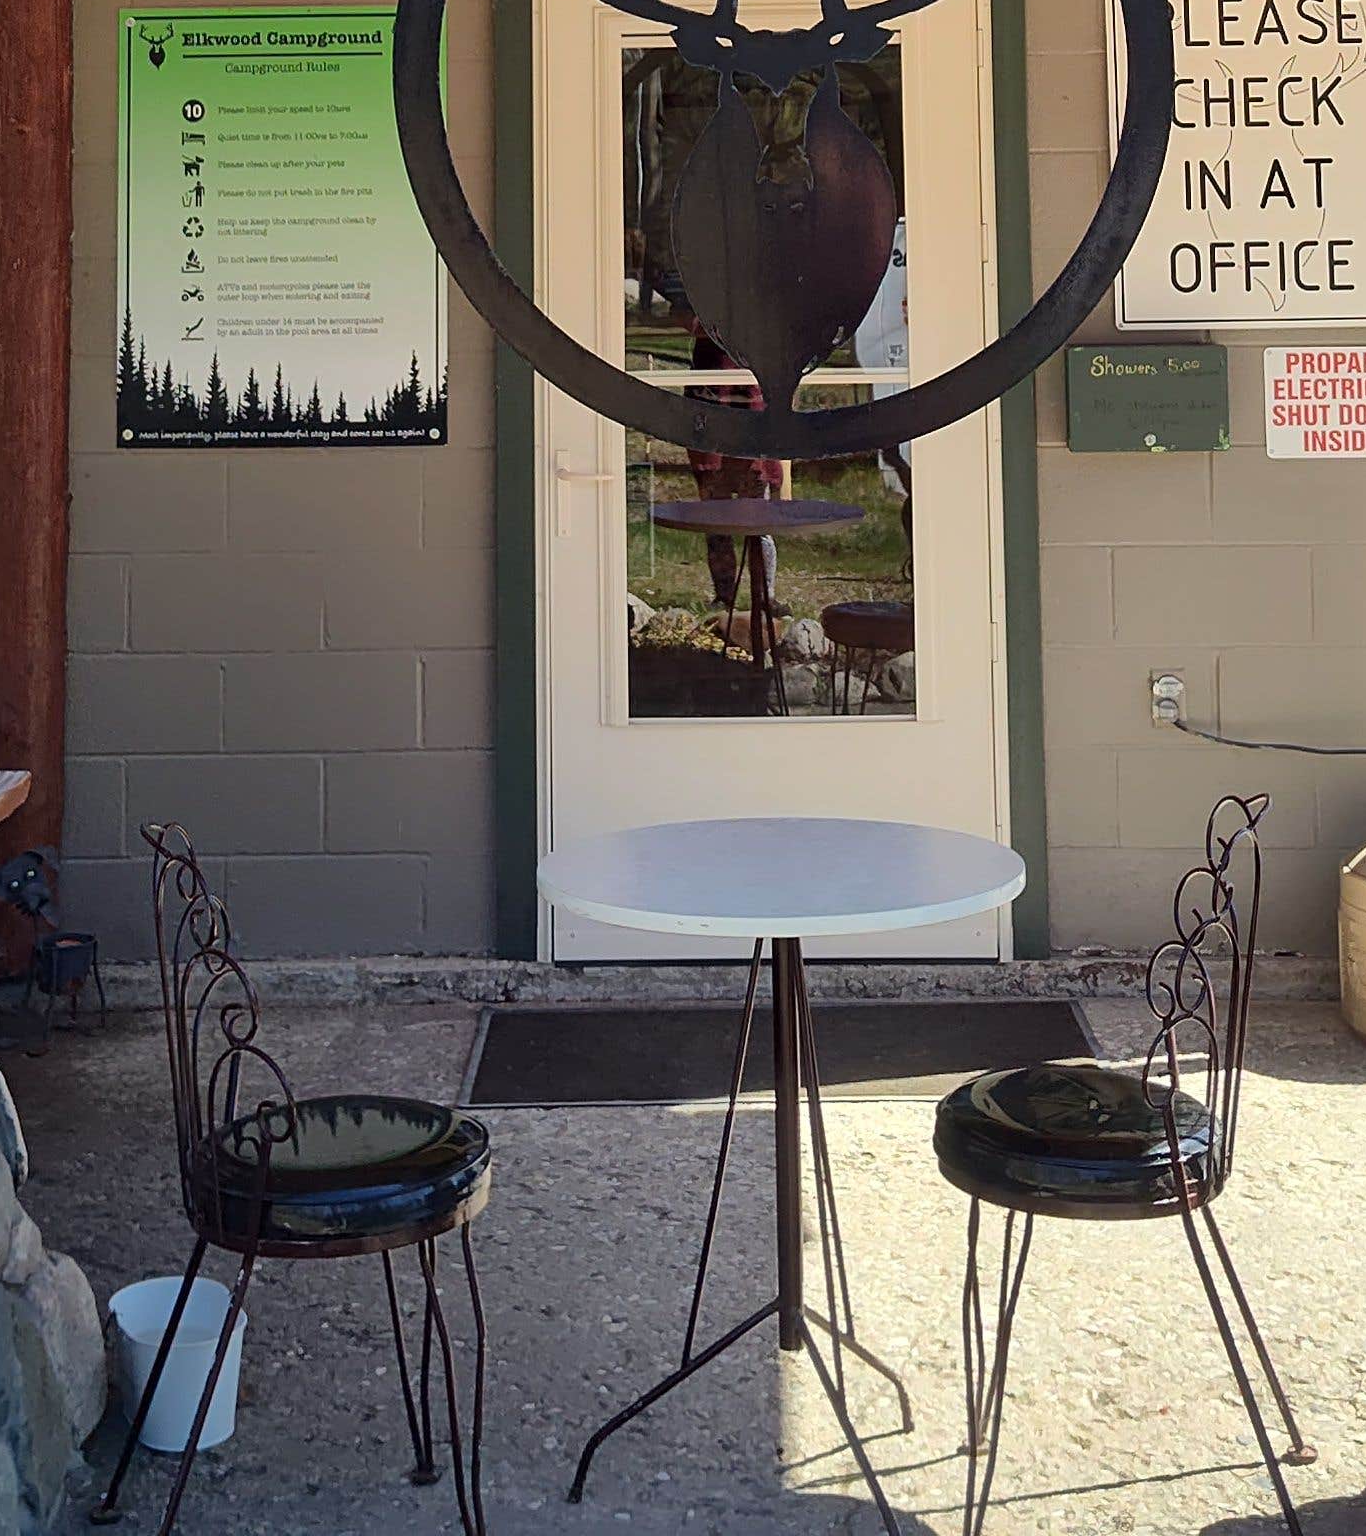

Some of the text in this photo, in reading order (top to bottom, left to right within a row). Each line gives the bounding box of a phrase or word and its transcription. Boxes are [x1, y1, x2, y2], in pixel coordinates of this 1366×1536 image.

[182, 31, 382, 47] Elkwood Campground
[225, 62, 340, 75] Campground Rules
[1173, 76, 1344, 128] CHECK
[185, 104, 202, 118] 10
[218, 105, 244, 114] Please
[267, 106, 288, 115] your
[271, 132, 292, 141] from
[218, 160, 244, 168] Please
[283, 160, 303, 168] after
[304, 161, 325, 170] your
[1185, 158, 1333, 210] IN AT
[325, 187, 338, 195] the
[287, 217, 340, 227] campground
[1170, 240, 1355, 293] OFFICE
[1091, 355, 1158, 376] Showers
[1272, 405, 1330, 426] SHUT
[267, 430, 308, 440] wonderful
[310, 430, 330, 440] stay
[331, 430, 348, 438] and
